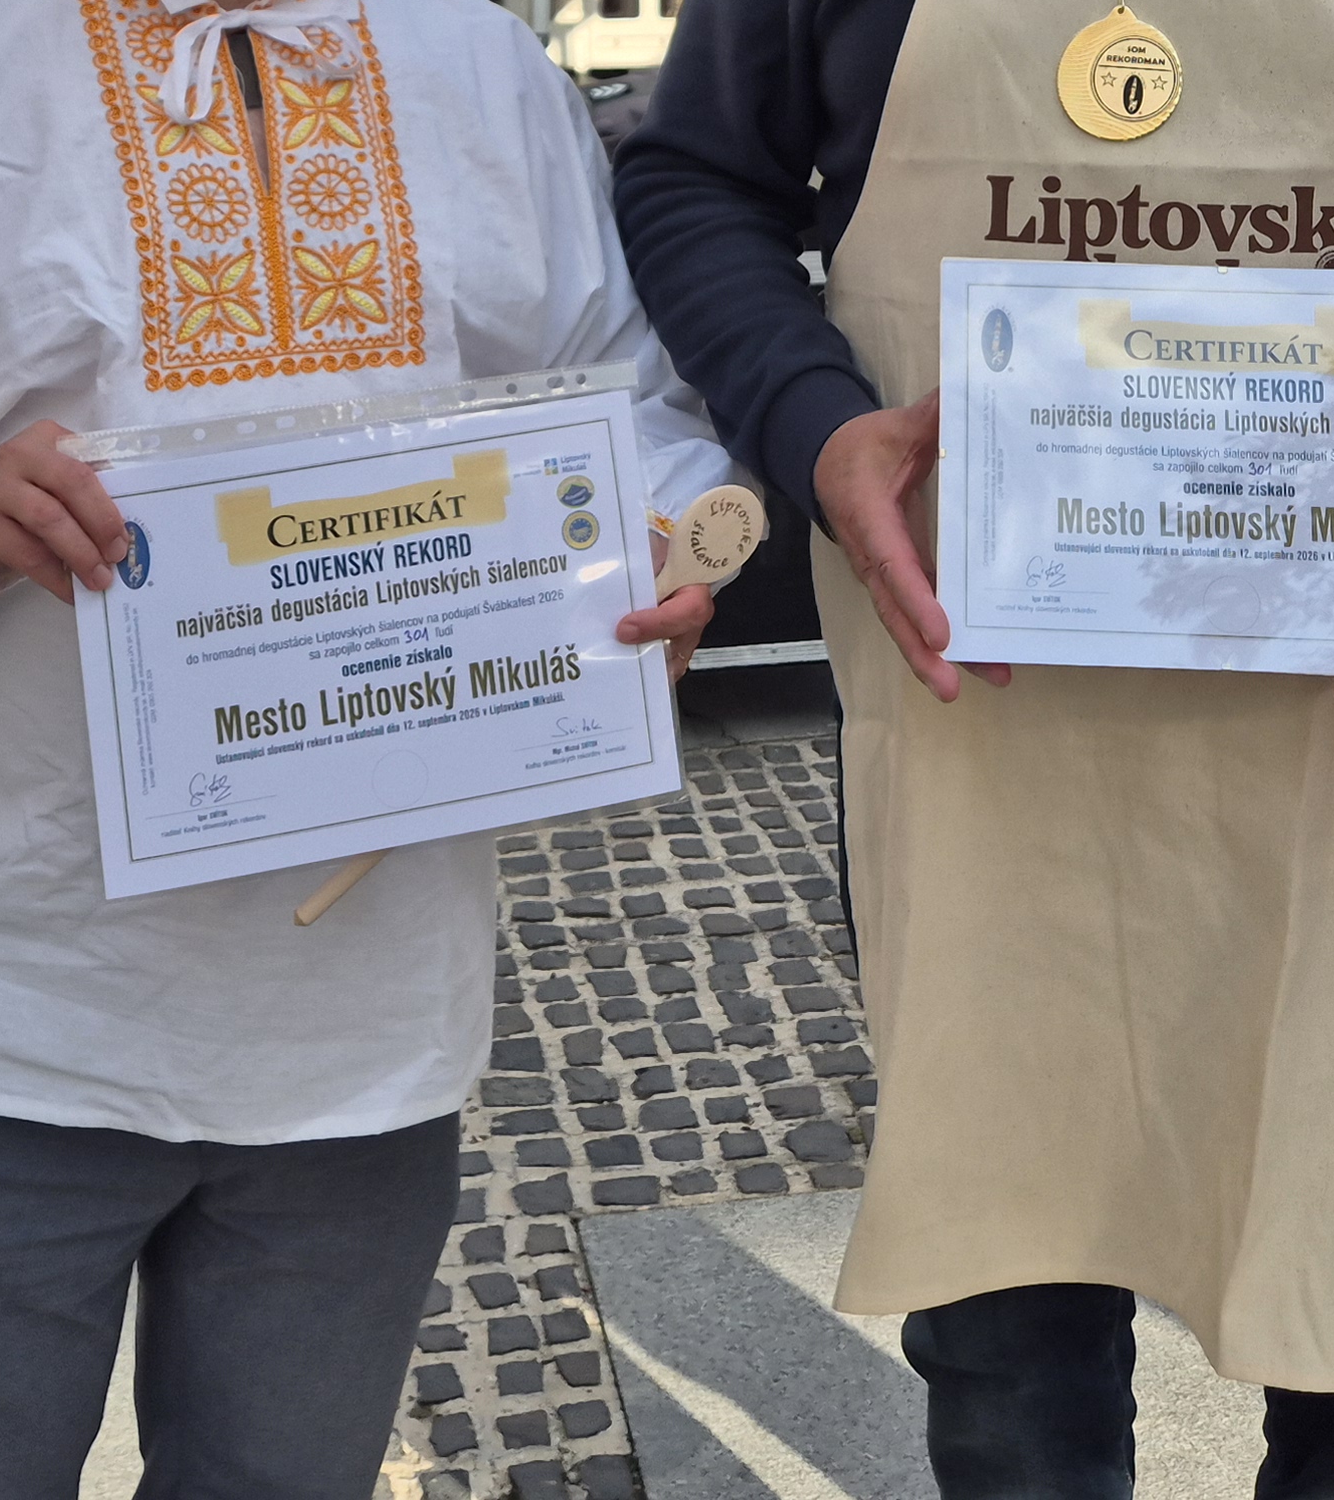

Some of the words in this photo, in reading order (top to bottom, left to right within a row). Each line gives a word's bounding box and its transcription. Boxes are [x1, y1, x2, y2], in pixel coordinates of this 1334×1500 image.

[1106, 54, 1166, 66] REKORDMAN
[1127, 45, 1147, 54] SOM
[1123, 372, 1236, 401] SLOVENSKÝ
[1245, 378, 1325, 404] REKORD
[1030, 404, 1112, 430] najväčšia
[1121, 406, 1216, 433] degustácia
[1224, 409, 1331, 438] Liptovských
[1036, 442, 1049, 453] do
[1051, 443, 1103, 457] hromadnej
[1105, 443, 1158, 457] degustácie
[1161, 445, 1220, 460] Liptovských
[1223, 447, 1269, 461] šialencov
[1272, 452, 1285, 461] na
[1288, 449, 1327, 463] podujatí
[1152, 462, 1164, 472] sa
[1167, 461, 1205, 475] zapojilo
[1208, 462, 1244, 474] celkom
[1183, 480, 1244, 496] ocenenie
[1248, 480, 1296, 498] získalo
[710, 497, 752, 555] Liptovské
[1057, 497, 1145, 537] Mesto
[1159, 501, 1297, 547] Liptovský
[270, 541, 385, 590] SLOVENSKÝ
[394, 532, 472, 569] REKORD
[1142, 545, 1168, 556] rekord
[1240, 548, 1252, 559] 12.
[1254, 550, 1294, 562] septembra
[1296, 551, 1318, 562] 2026
[176, 603, 263, 638] najväčšia
[271, 585, 369, 622] degustácia
[376, 565, 481, 605] Liptovských
[487, 554, 567, 585] šialencov
[186, 653, 199, 666] do
[202, 644, 256, 662] hromadnej
[258, 635, 313, 654] degustácie
[316, 622, 376, 644] Liptovských
[378, 615, 424, 632] šialencov
[426, 613, 439, 623] na
[442, 605, 481, 623] podujatí
[483, 595, 536, 615] Švábkafest
[538, 589, 564, 604] 2026
[309, 650, 321, 660] sa
[324, 642, 362, 659] zapojilo
[364, 636, 400, 651] celkom
[341, 653, 402, 677] ocenenie
[406, 644, 453, 666] získalo
[214, 698, 306, 745] Mesto
[319, 666, 456, 728] Liptovský
[468, 643, 581, 699] Mikuláš
[267, 739, 304, 756] slovenský
[307, 735, 332, 749] rekord
[403, 720, 416, 731] 12.
[418, 713, 457, 729] septembra
[459, 706, 481, 721] 2026
[489, 700, 531, 717] Liptovskom
